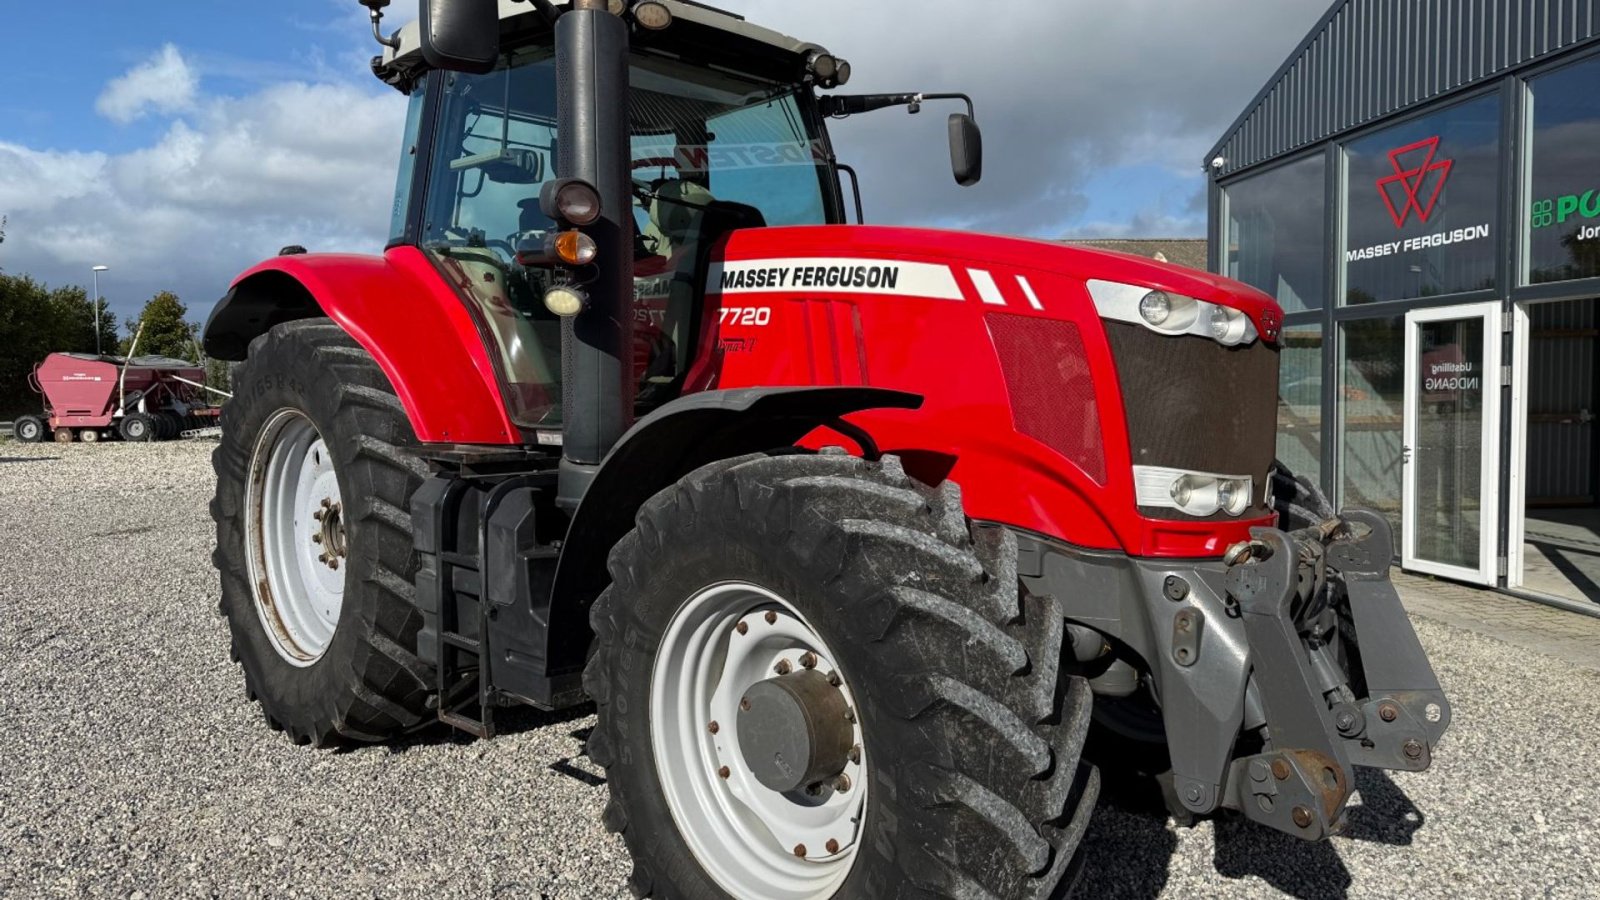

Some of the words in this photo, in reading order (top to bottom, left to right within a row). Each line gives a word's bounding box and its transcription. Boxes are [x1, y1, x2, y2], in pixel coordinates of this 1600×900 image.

[1346, 241, 1401, 263] MASSEY
[1403, 224, 1489, 252] FERGUSON
[720, 267, 789, 289] MASSEY
[792, 266, 899, 288] FERGUSON
[717, 307, 771, 326] 7720
